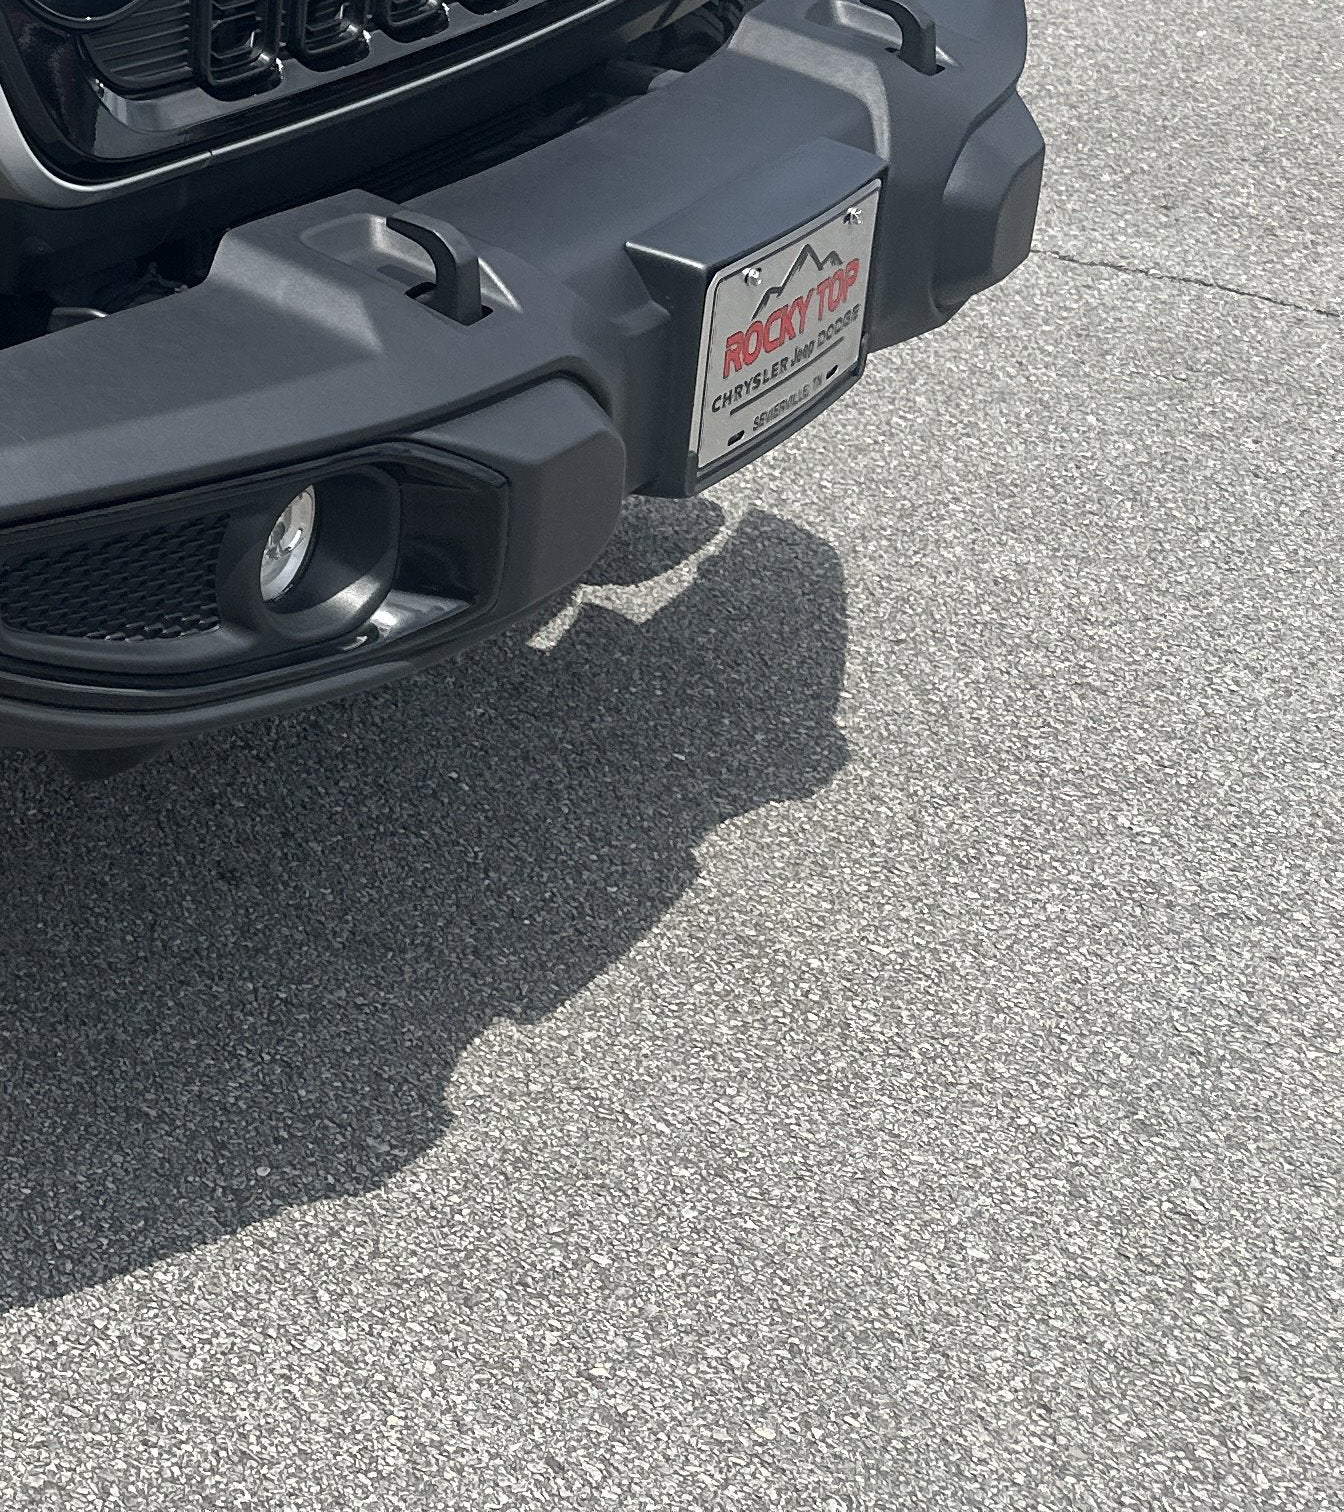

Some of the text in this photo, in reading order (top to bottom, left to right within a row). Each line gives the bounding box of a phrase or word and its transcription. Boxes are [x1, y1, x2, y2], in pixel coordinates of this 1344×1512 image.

[723, 257, 860, 379] ROCKY TOP
[711, 356, 788, 413] CHRYSLER
